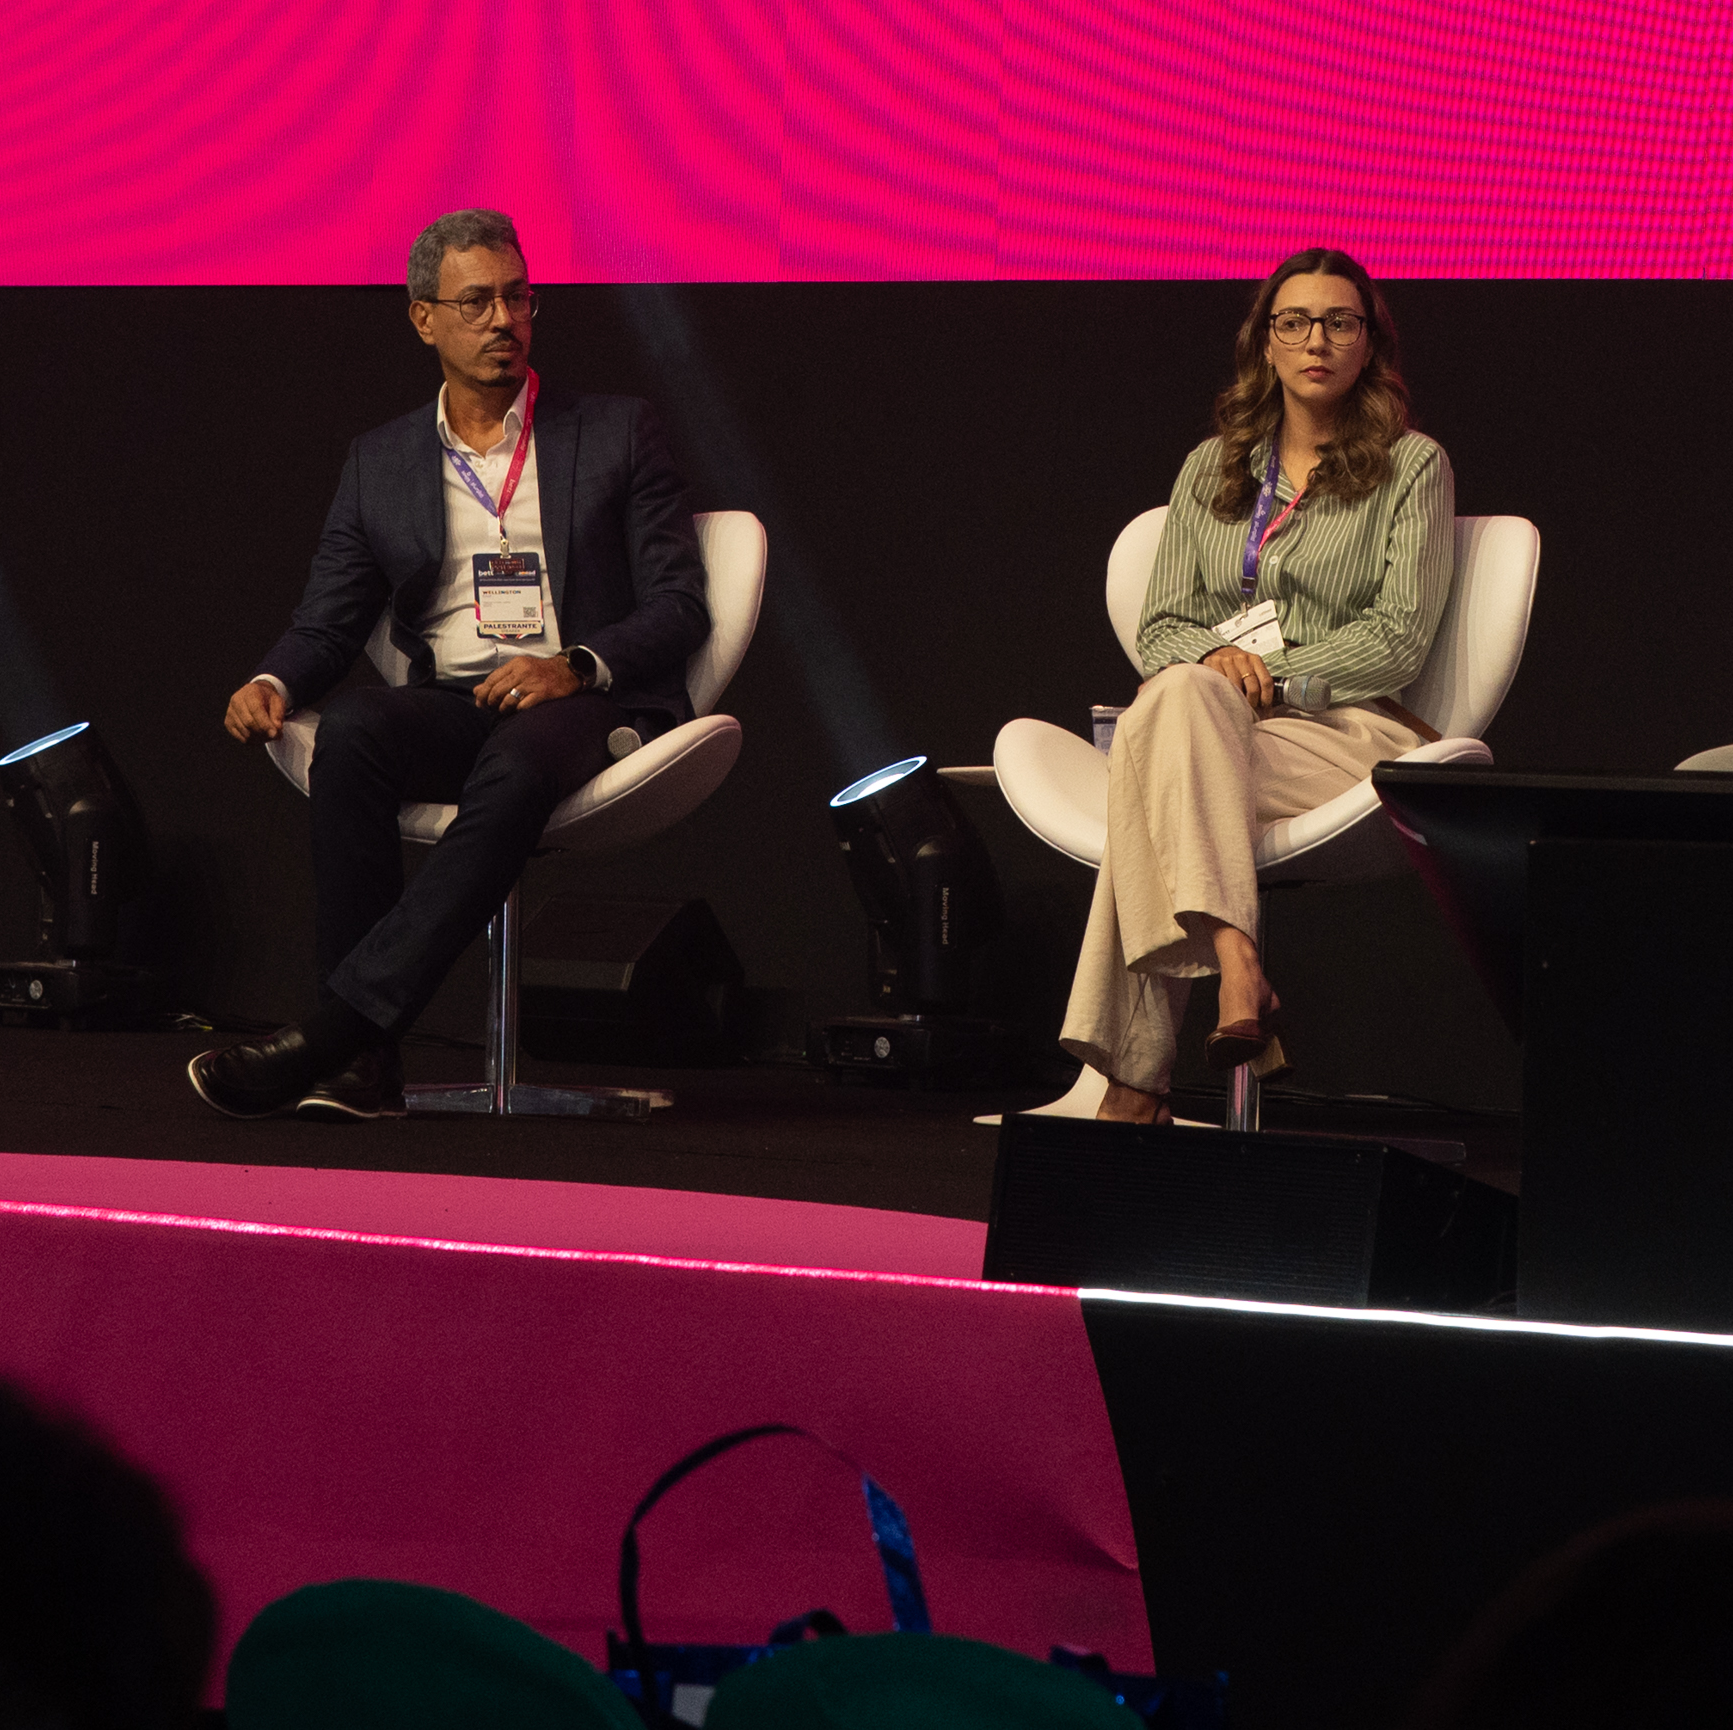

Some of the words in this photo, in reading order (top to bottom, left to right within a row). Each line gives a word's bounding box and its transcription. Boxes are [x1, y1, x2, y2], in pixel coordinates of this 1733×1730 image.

[89, 840, 100, 872] Moving
[90, 873, 99, 896] Head
[941, 887, 950, 921] Moving
[942, 922, 950, 945] Head
